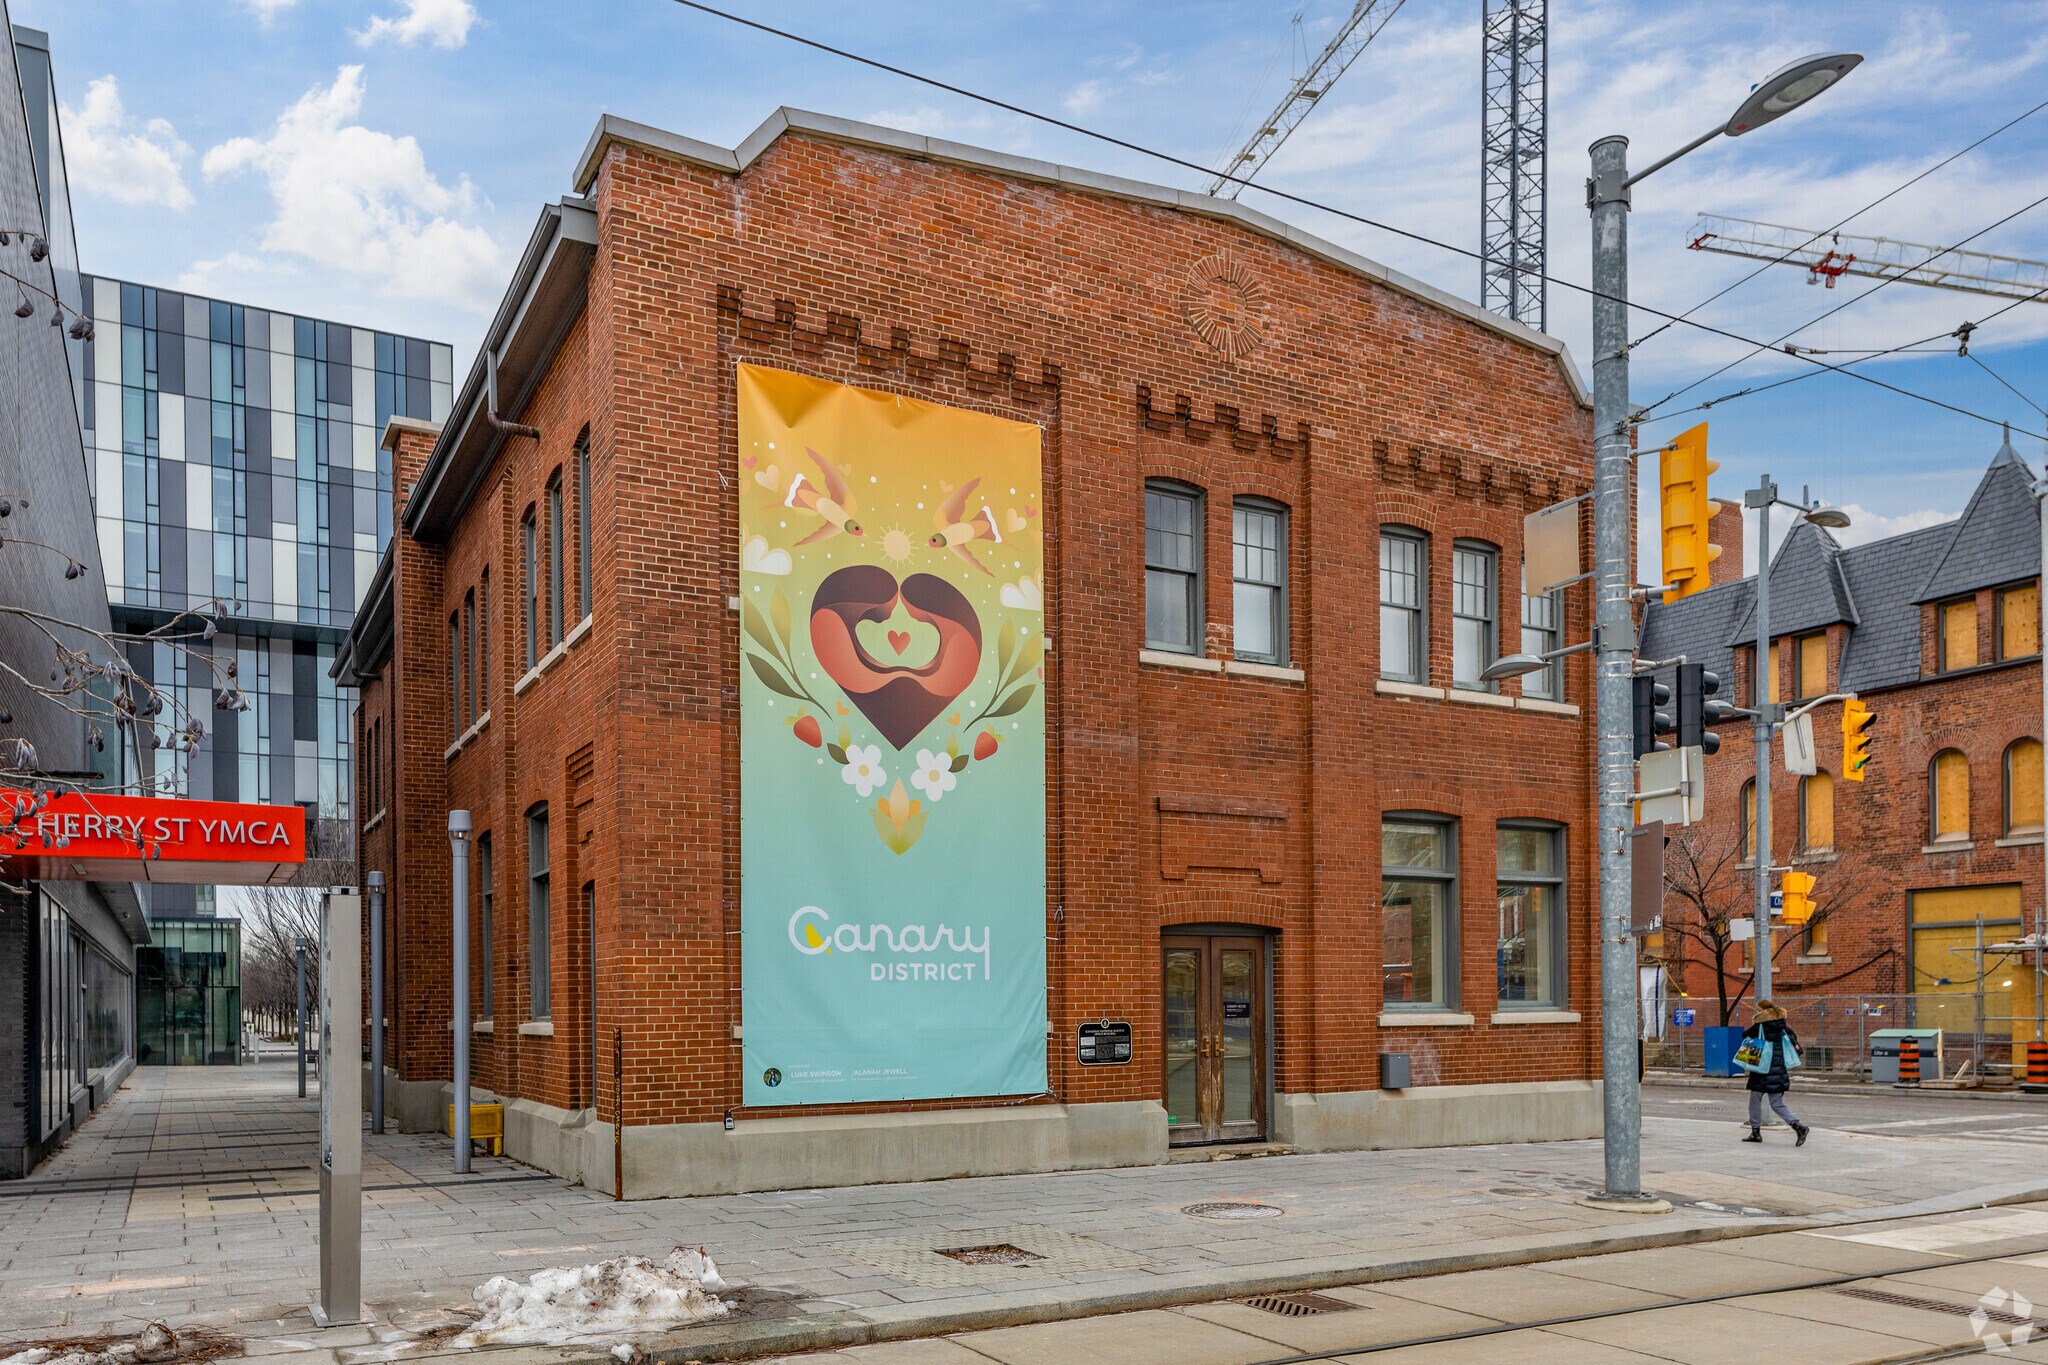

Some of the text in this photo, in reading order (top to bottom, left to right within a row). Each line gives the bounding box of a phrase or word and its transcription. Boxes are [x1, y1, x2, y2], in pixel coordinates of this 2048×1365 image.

[154, 816, 191, 841] ST
[199, 819, 290, 846] YMCA
[788, 905, 990, 980] Canary
[870, 963, 976, 981] DISTRICT
[810, 1069, 842, 1077] SWINSON
